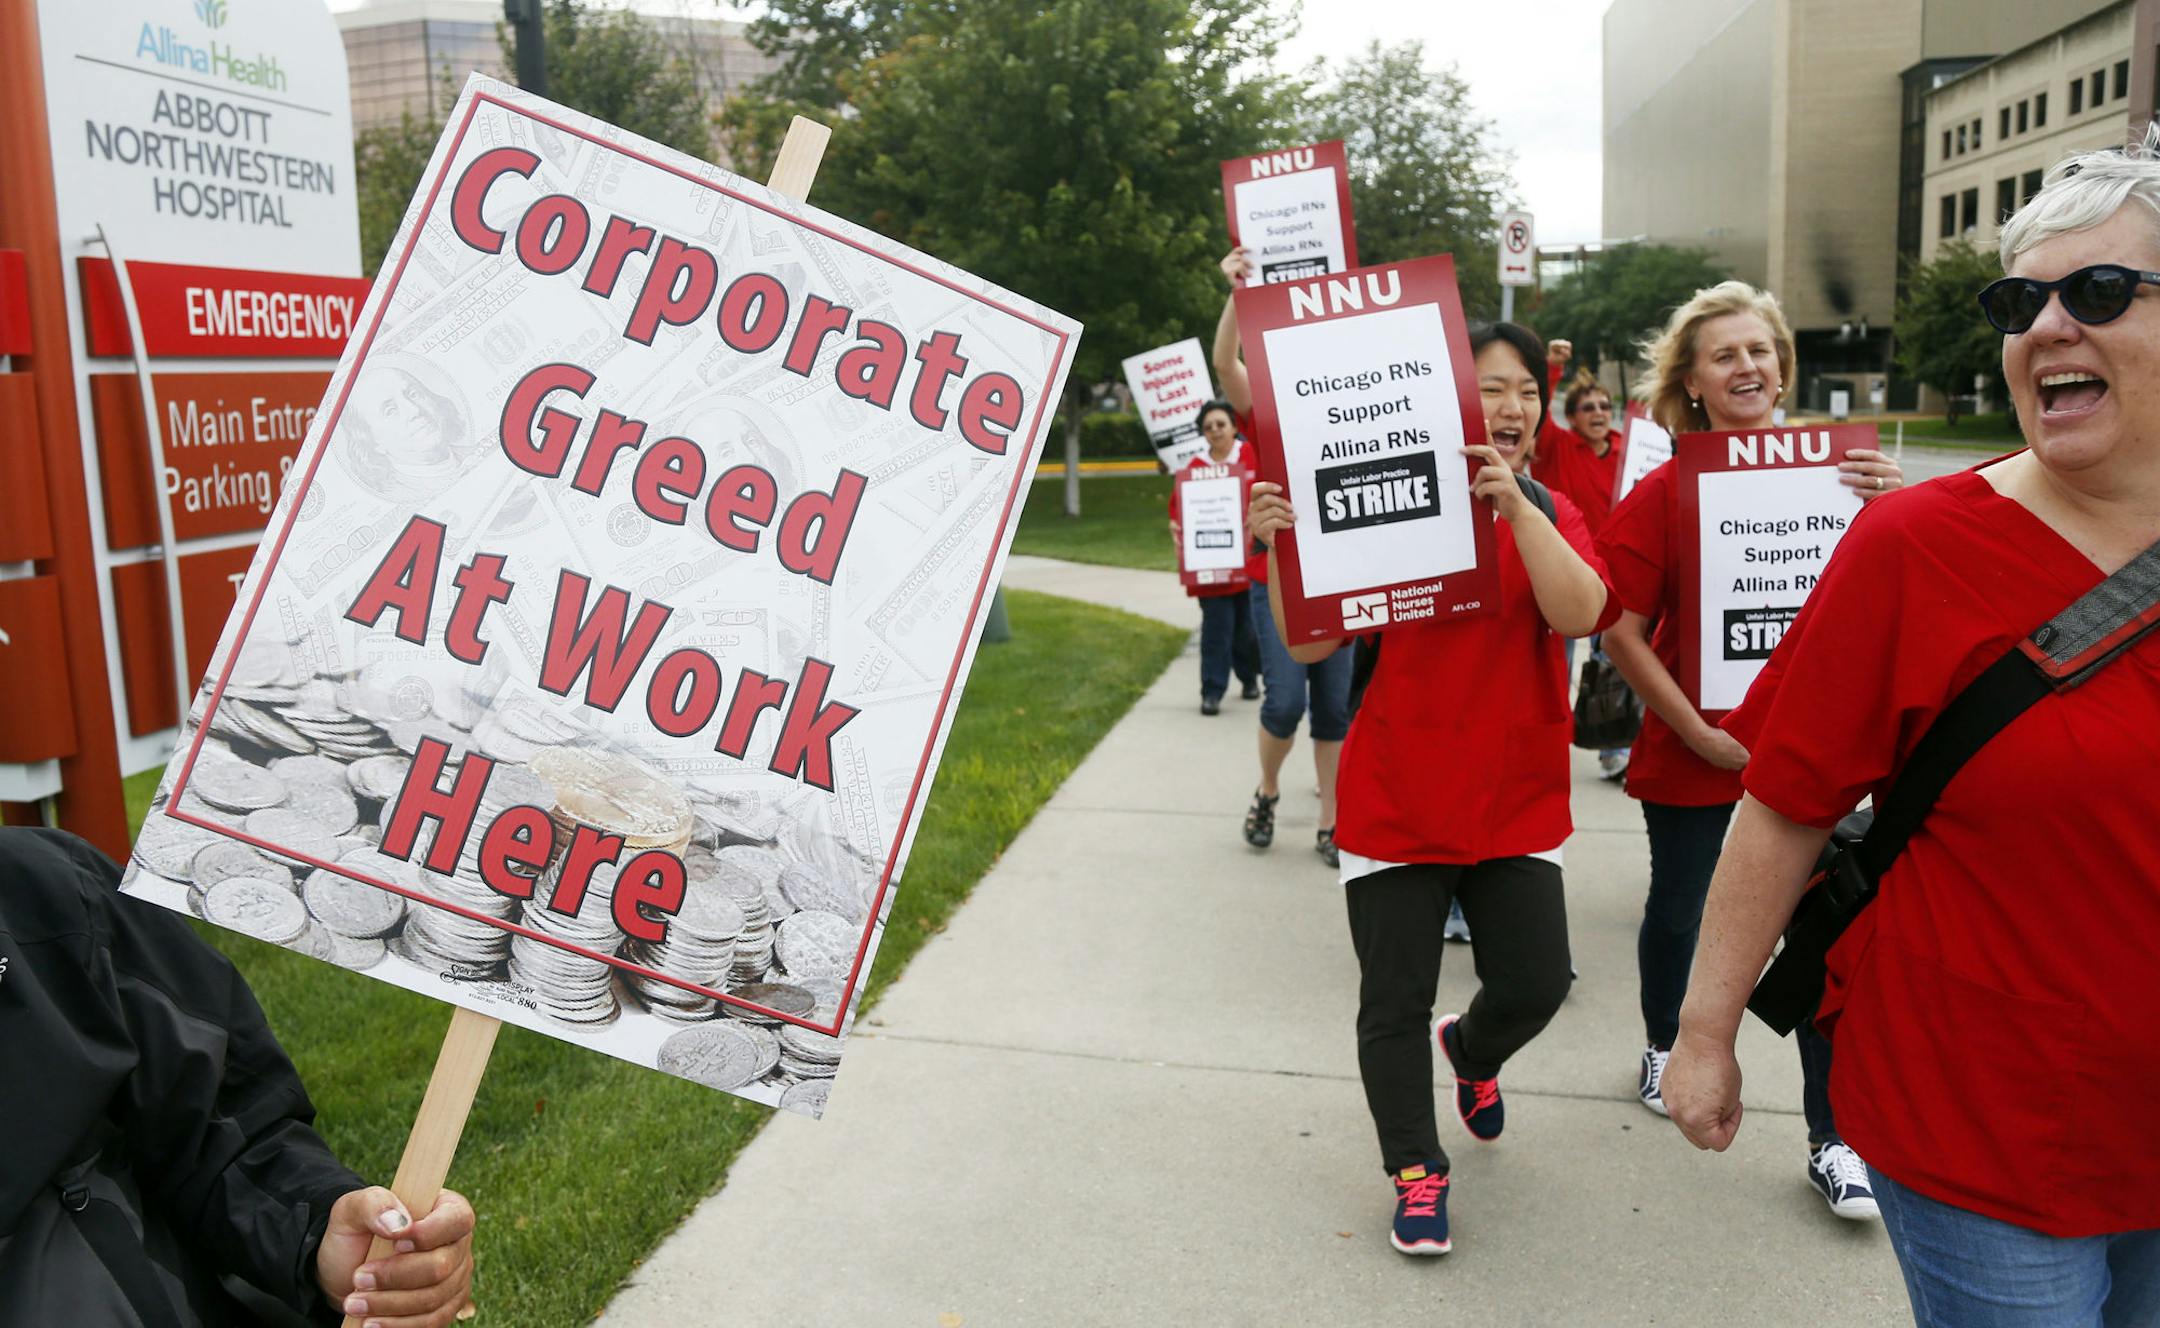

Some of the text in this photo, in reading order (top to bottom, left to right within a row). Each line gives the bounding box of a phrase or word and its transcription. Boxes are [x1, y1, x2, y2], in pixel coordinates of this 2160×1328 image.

[152, 89, 272, 144] ABBOTT
[85, 119, 335, 195] NORTHWESTERN
[1250, 148, 1315, 179] NNU
[153, 176, 293, 228] HOSPITAL
[1301, 200, 1326, 212] RNs
[1266, 221, 1313, 236] Support
[1299, 239, 1323, 250] RNs
[450, 146, 1024, 455] Corporate
[1288, 269, 1401, 320] NNU
[185, 286, 355, 339] EMERGENCY
[1143, 356, 1184, 374] Some
[1295, 360, 1432, 397] Chicago RNs
[1142, 369, 1195, 391] Injuries
[1156, 385, 1188, 403] Last
[167, 400, 245, 448] Main
[1328, 395, 1412, 424] Support
[1321, 428, 1431, 461] Allina RNs
[1728, 431, 1831, 466] NNU
[164, 460, 272, 514] Parking
[500, 362, 869, 586] Greed
[1190, 465, 1229, 480] NNU
[1340, 468, 1410, 486] Unfair Labor Practice
[1324, 475, 1431, 522] STRIKE
[1720, 515, 1846, 536] Chicago RNs
[1744, 544, 1822, 564] Support
[1391, 581, 1443, 600] National
[1732, 576, 1787, 592] Allina
[1392, 595, 1435, 611] Nurses
[1393, 606, 1435, 622] United
[1765, 612, 1784, 620] Labor
[343, 514, 861, 793] At Work
[377, 734, 688, 945] Here
[517, 997, 538, 1010] 880
